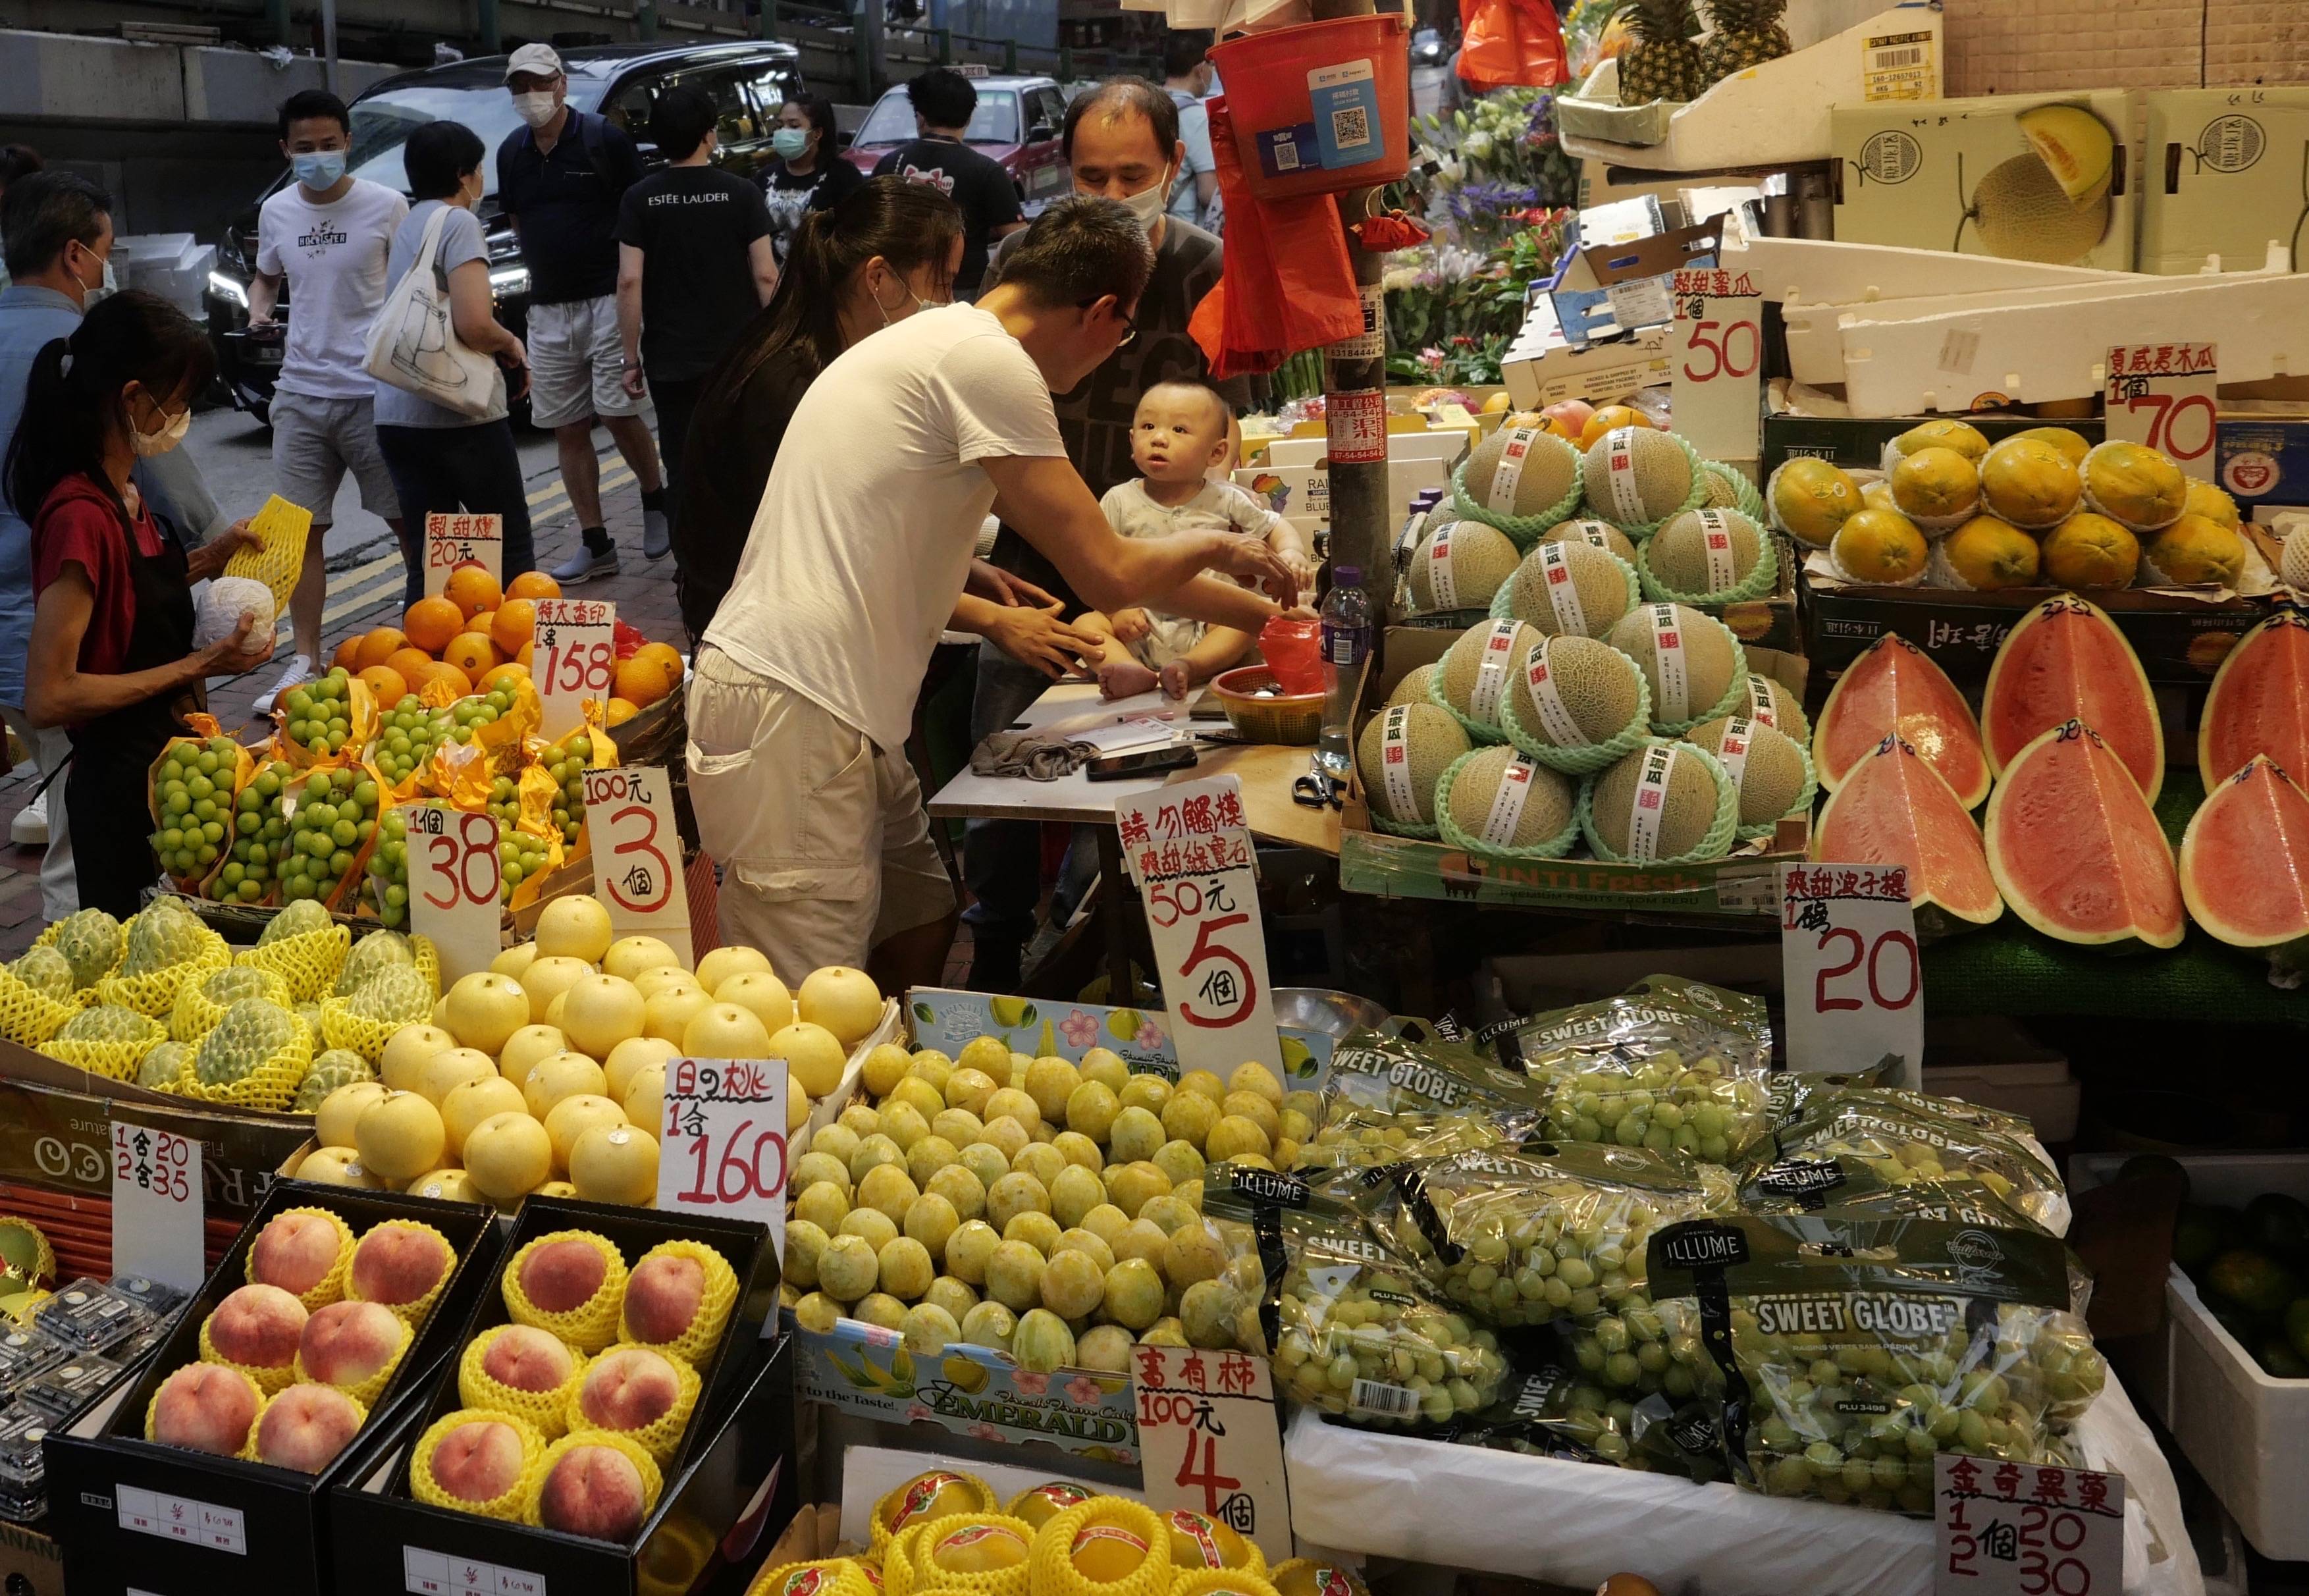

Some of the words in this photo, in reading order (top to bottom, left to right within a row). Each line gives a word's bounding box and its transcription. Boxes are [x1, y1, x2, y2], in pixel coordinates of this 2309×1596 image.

[683, 193, 729, 204] LAUDER
[299, 234, 346, 246] HOLLISTER
[1675, 298, 1704, 319] 1個
[1684, 321, 1759, 382] 50
[2107, 378, 2149, 405] 1個
[2129, 395, 2216, 460] 70
[431, 541, 475, 568] 20元
[1826, 622, 1878, 636] 日本引進
[544, 640, 612, 696] 158
[585, 774, 651, 806] 100元
[409, 809, 444, 835] 1個
[423, 812, 499, 910] 38
[1150, 879, 1236, 928] 50元
[1500, 890, 1563, 900] PREMIUM
[1568, 892, 1613, 903] FRUITS
[1616, 894, 1658, 905] FROM
[1662, 895, 1699, 905] PERU
[1816, 926, 1919, 1014] 20
[1480, 1017, 1529, 1043] ILLUME
[1539, 1018, 1608, 1045] SWEET
[676, 1059, 772, 1098] 日の桃
[1802, 1115, 1873, 1149] SWEET
[156, 1132, 189, 1167] 20
[677, 1120, 787, 1204] 160
[153, 1165, 190, 1203] 35
[1239, 1176, 1302, 1202] ILLUME
[1767, 1167, 1836, 1186] ILLUME
[1307, 1236, 1387, 1261] SWEET
[1666, 1236, 1740, 1260] ILLUME
[1760, 1301, 1845, 1333] SWEET
[807, 1386, 823, 1398] to
[826, 1388, 850, 1402] the
[1860, 1404, 1886, 1412] 3498
[932, 1391, 1127, 1443] EMERALD
[1138, 1393, 1226, 1437] 100元
[2018, 1505, 2086, 1551] 20
[2019, 1551, 2091, 1596] 30
